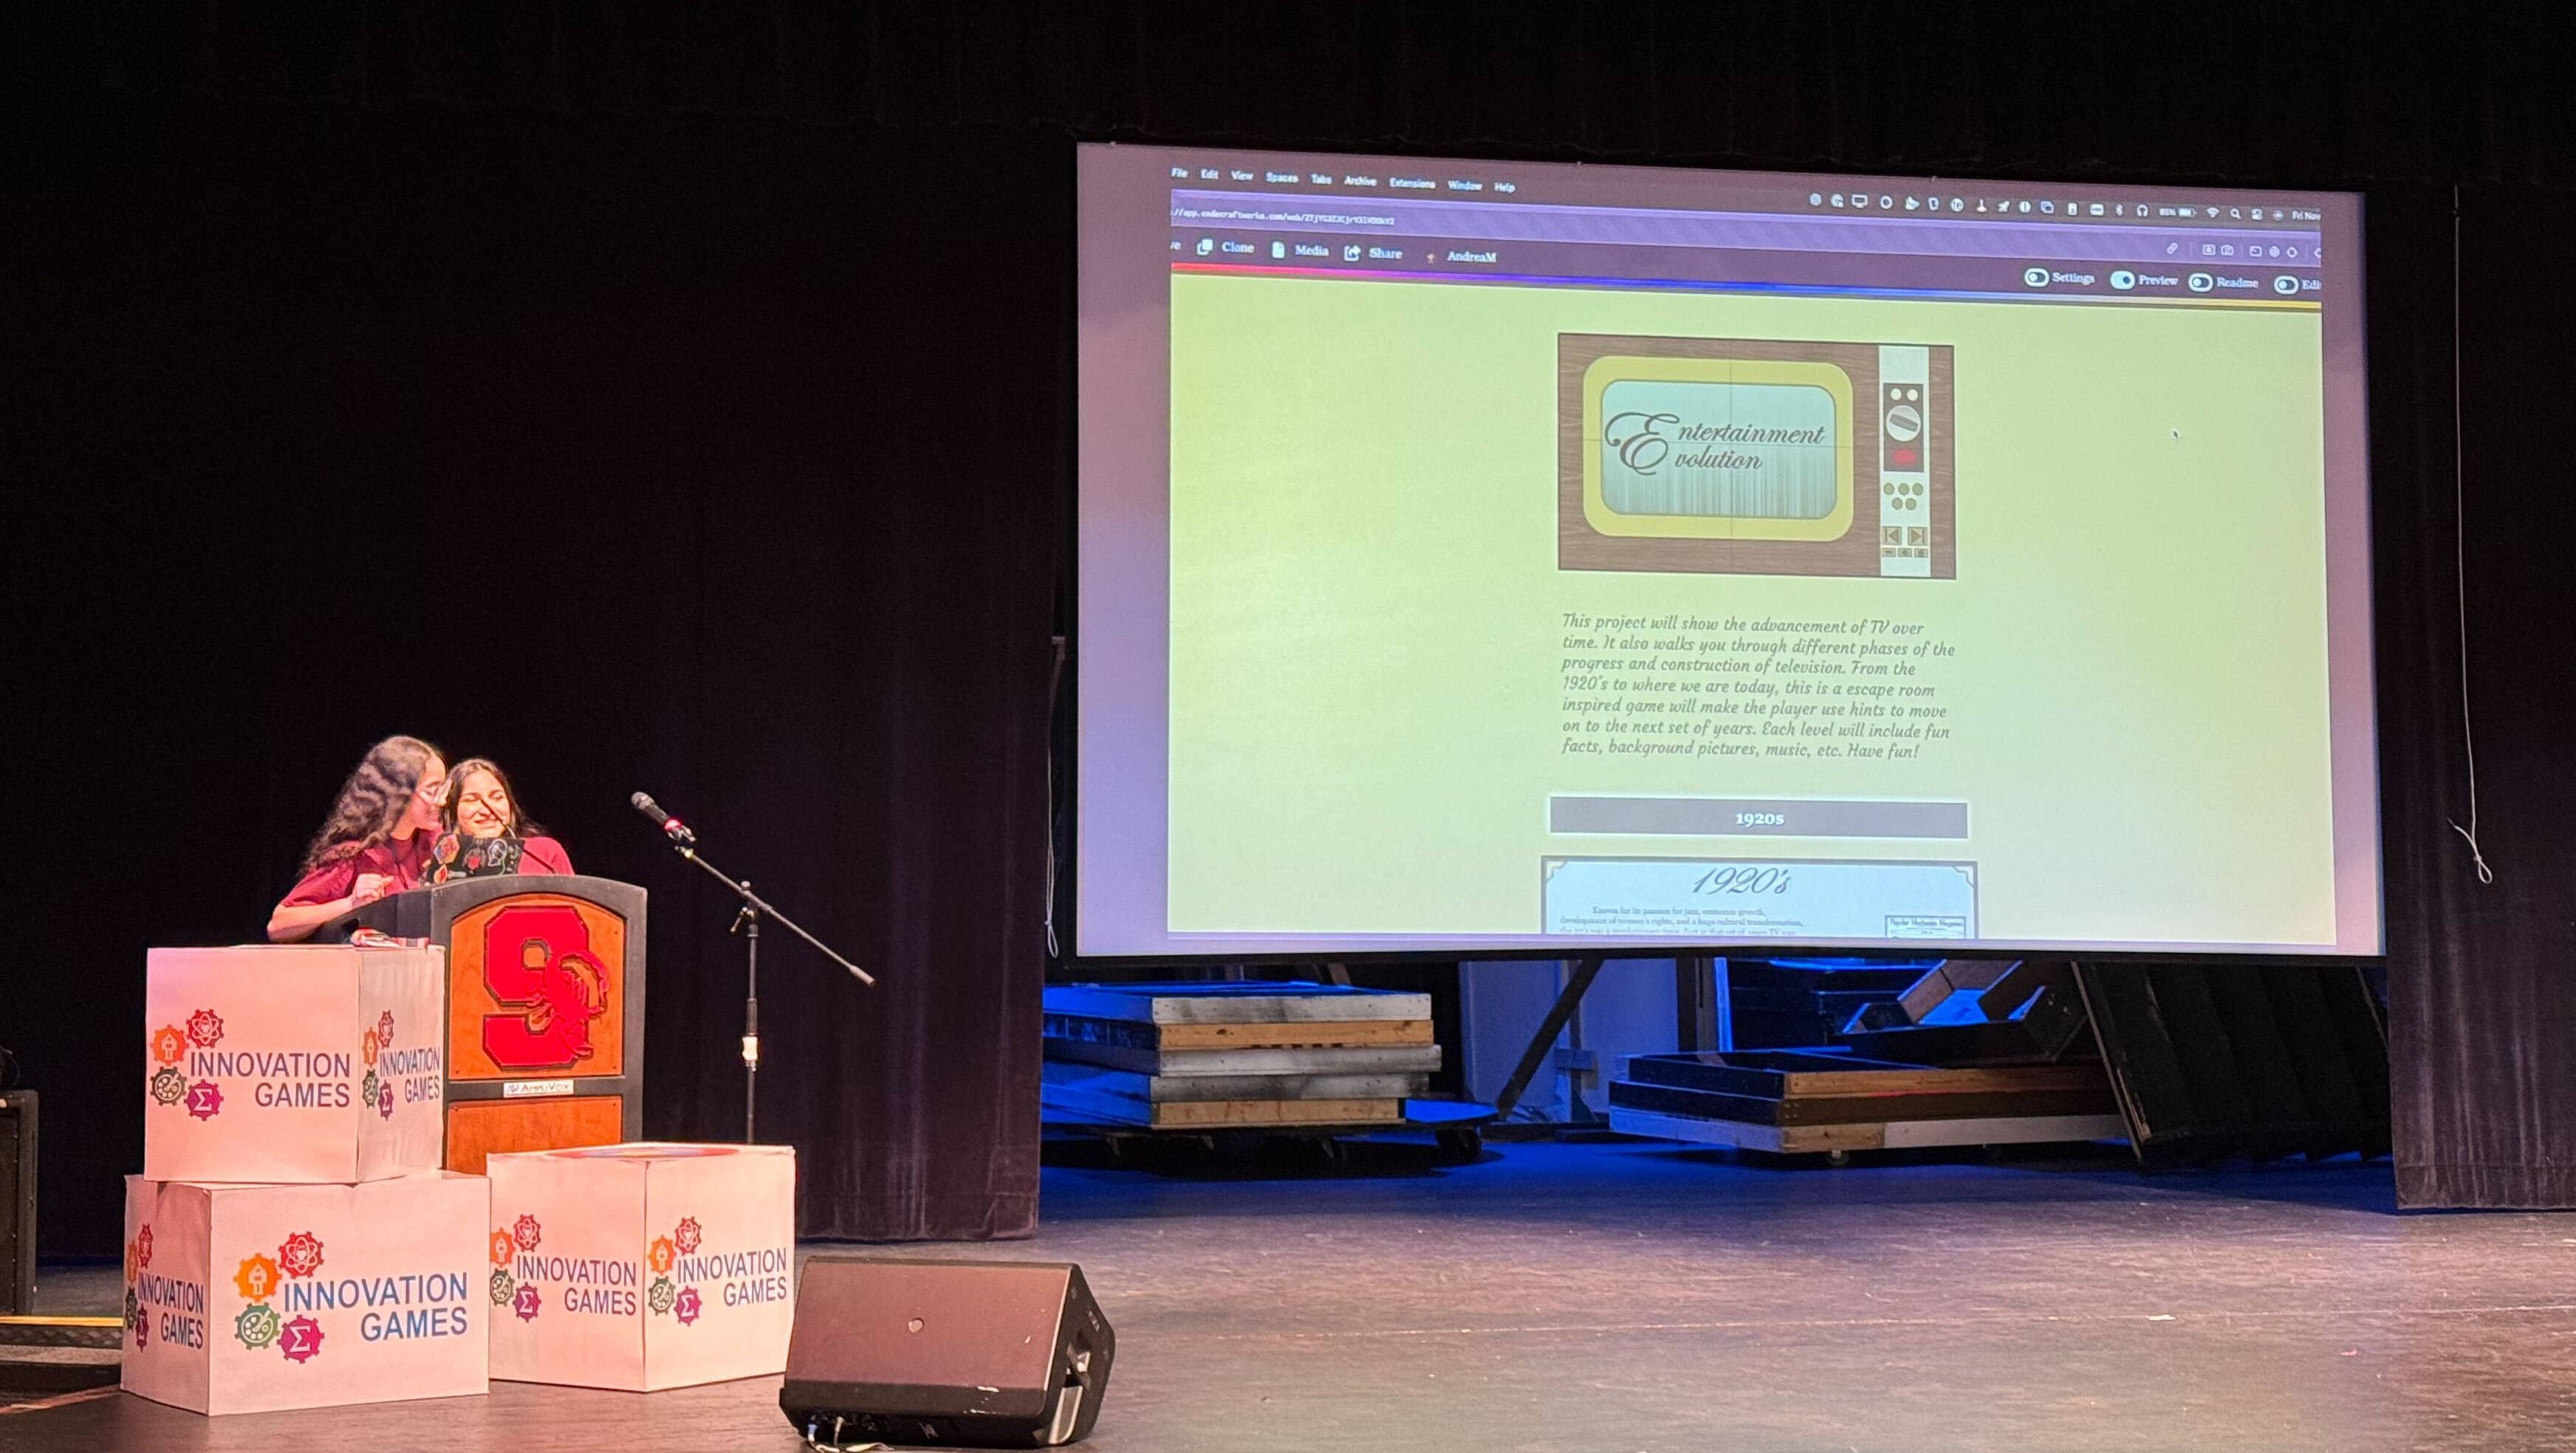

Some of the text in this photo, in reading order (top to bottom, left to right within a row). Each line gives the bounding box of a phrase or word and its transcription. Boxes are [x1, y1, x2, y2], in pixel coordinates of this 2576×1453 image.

[1171, 168, 1516, 193] File Edit View Spaces Tabs Archive Extensions Window Help
[2292, 211, 2303, 220] Fri
[1222, 242, 1255, 253] Clone
[1295, 245, 1329, 256] Media
[1368, 247, 1403, 259] Share
[1448, 251, 1496, 263] AndreaM
[2052, 273, 2096, 285] Settings
[2139, 275, 2178, 286] Preview
[2217, 277, 2258, 289] Readme
[1563, 612, 1925, 636] This project will show the advancement of TV over
[1563, 634, 1956, 659] time. It also walks you through different phases of the
[1561, 655, 1916, 676] progress and construction of television. From the
[1563, 674, 1935, 700] 1920's to where we are today, this is a escape room
[1562, 697, 1947, 719] inspired game will make the player use hints to move
[1562, 717, 1950, 740] on to the next set of years. Each level will include fun
[1561, 736, 1921, 760] facts, background pictures, music, etc. Have fun!
[1736, 811, 1785, 827] 1920s
[1692, 867, 1792, 895] 1920's
[190, 1052, 350, 1078] INNOVATION
[379, 1047, 441, 1078] INNOVATION
[255, 1083, 350, 1108] GAMES
[405, 1076, 440, 1104] GAMES
[517, 1256, 637, 1286] INNOVATION
[677, 1248, 787, 1284] INNOVATION
[138, 1271, 204, 1314] INNOVATION
[285, 1272, 468, 1313] INNOVATION
[564, 1288, 637, 1316] GAMES
[723, 1276, 787, 1307] GAMES
[160, 1316, 204, 1350] GAMES
[361, 1307, 468, 1342] GAMES
